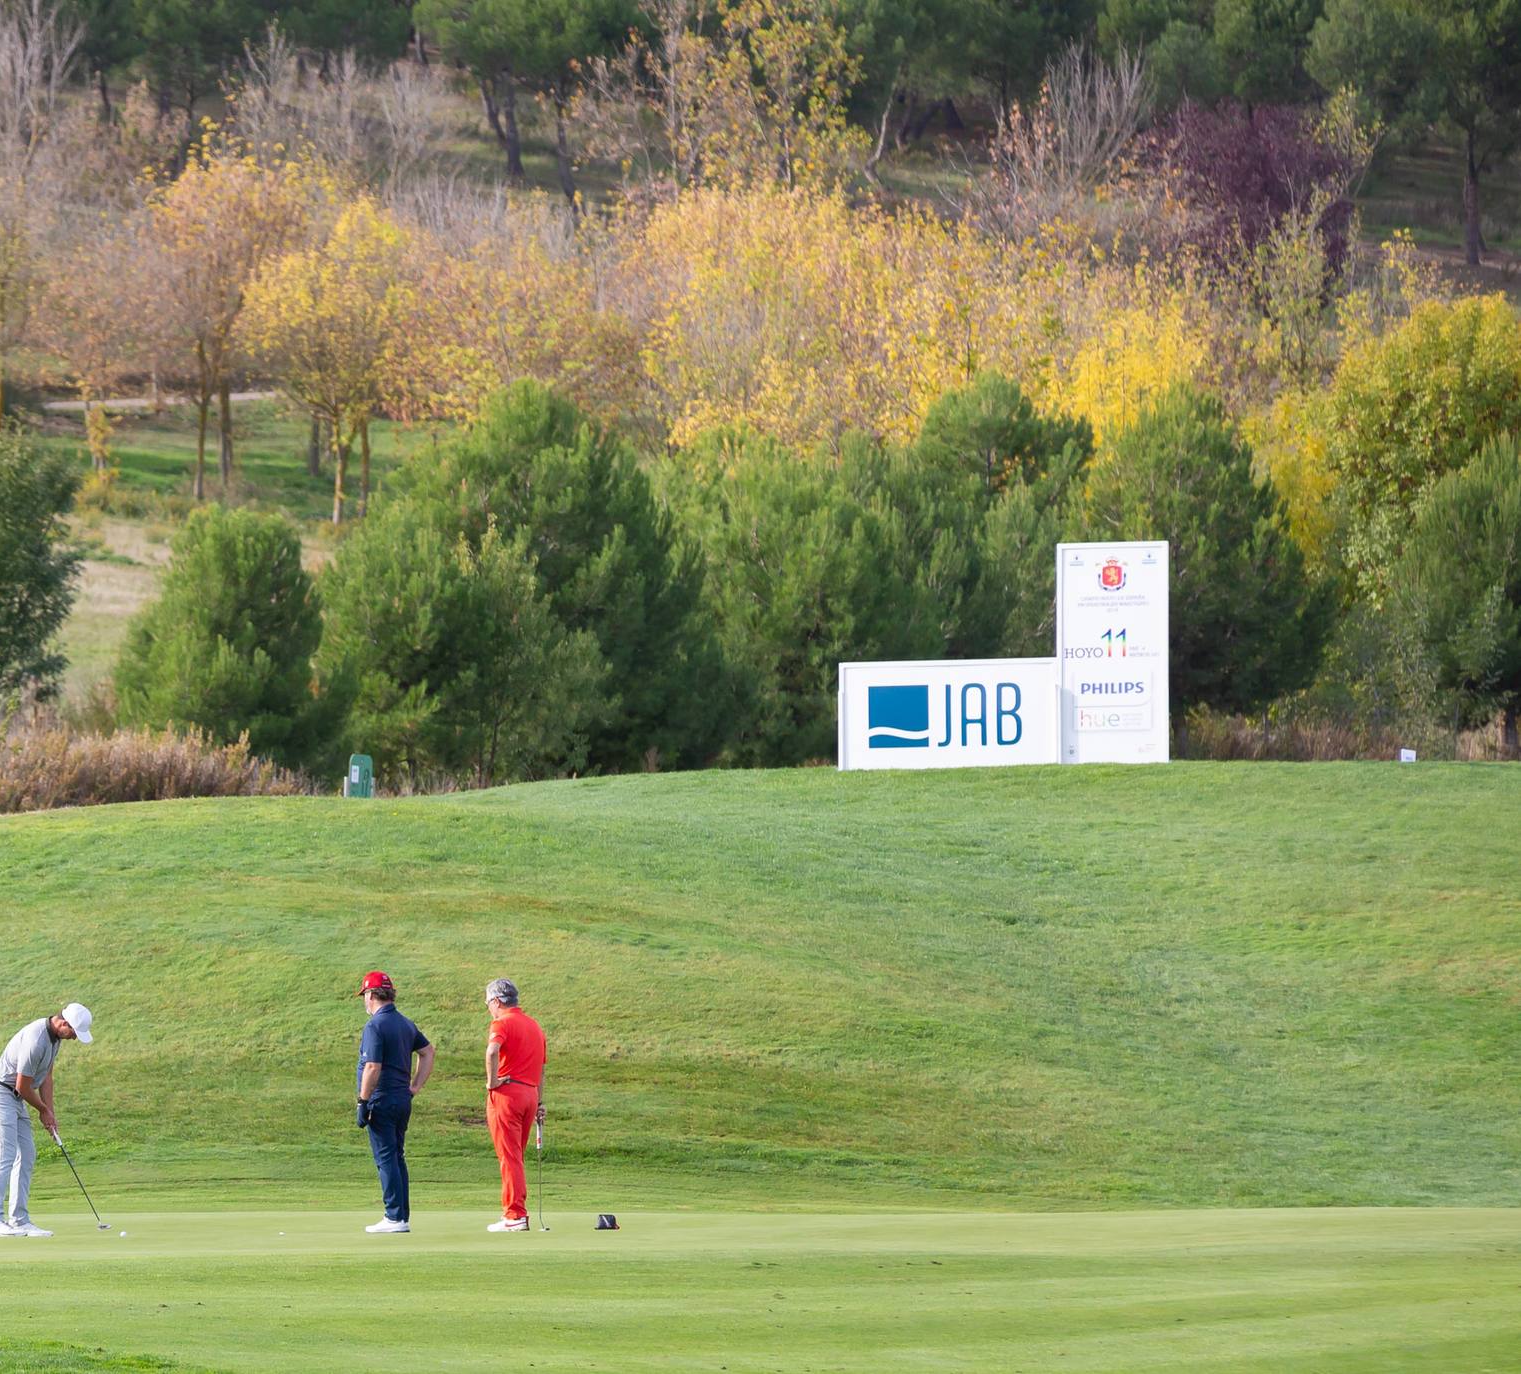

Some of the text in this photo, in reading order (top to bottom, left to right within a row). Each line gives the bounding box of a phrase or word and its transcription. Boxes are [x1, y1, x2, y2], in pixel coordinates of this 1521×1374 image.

[1064, 628, 1127, 659] HOYO 11
[1080, 681, 1145, 695] PHILIPS
[937, 682, 1023, 748] JAB
[1080, 709, 1121, 728] hue
